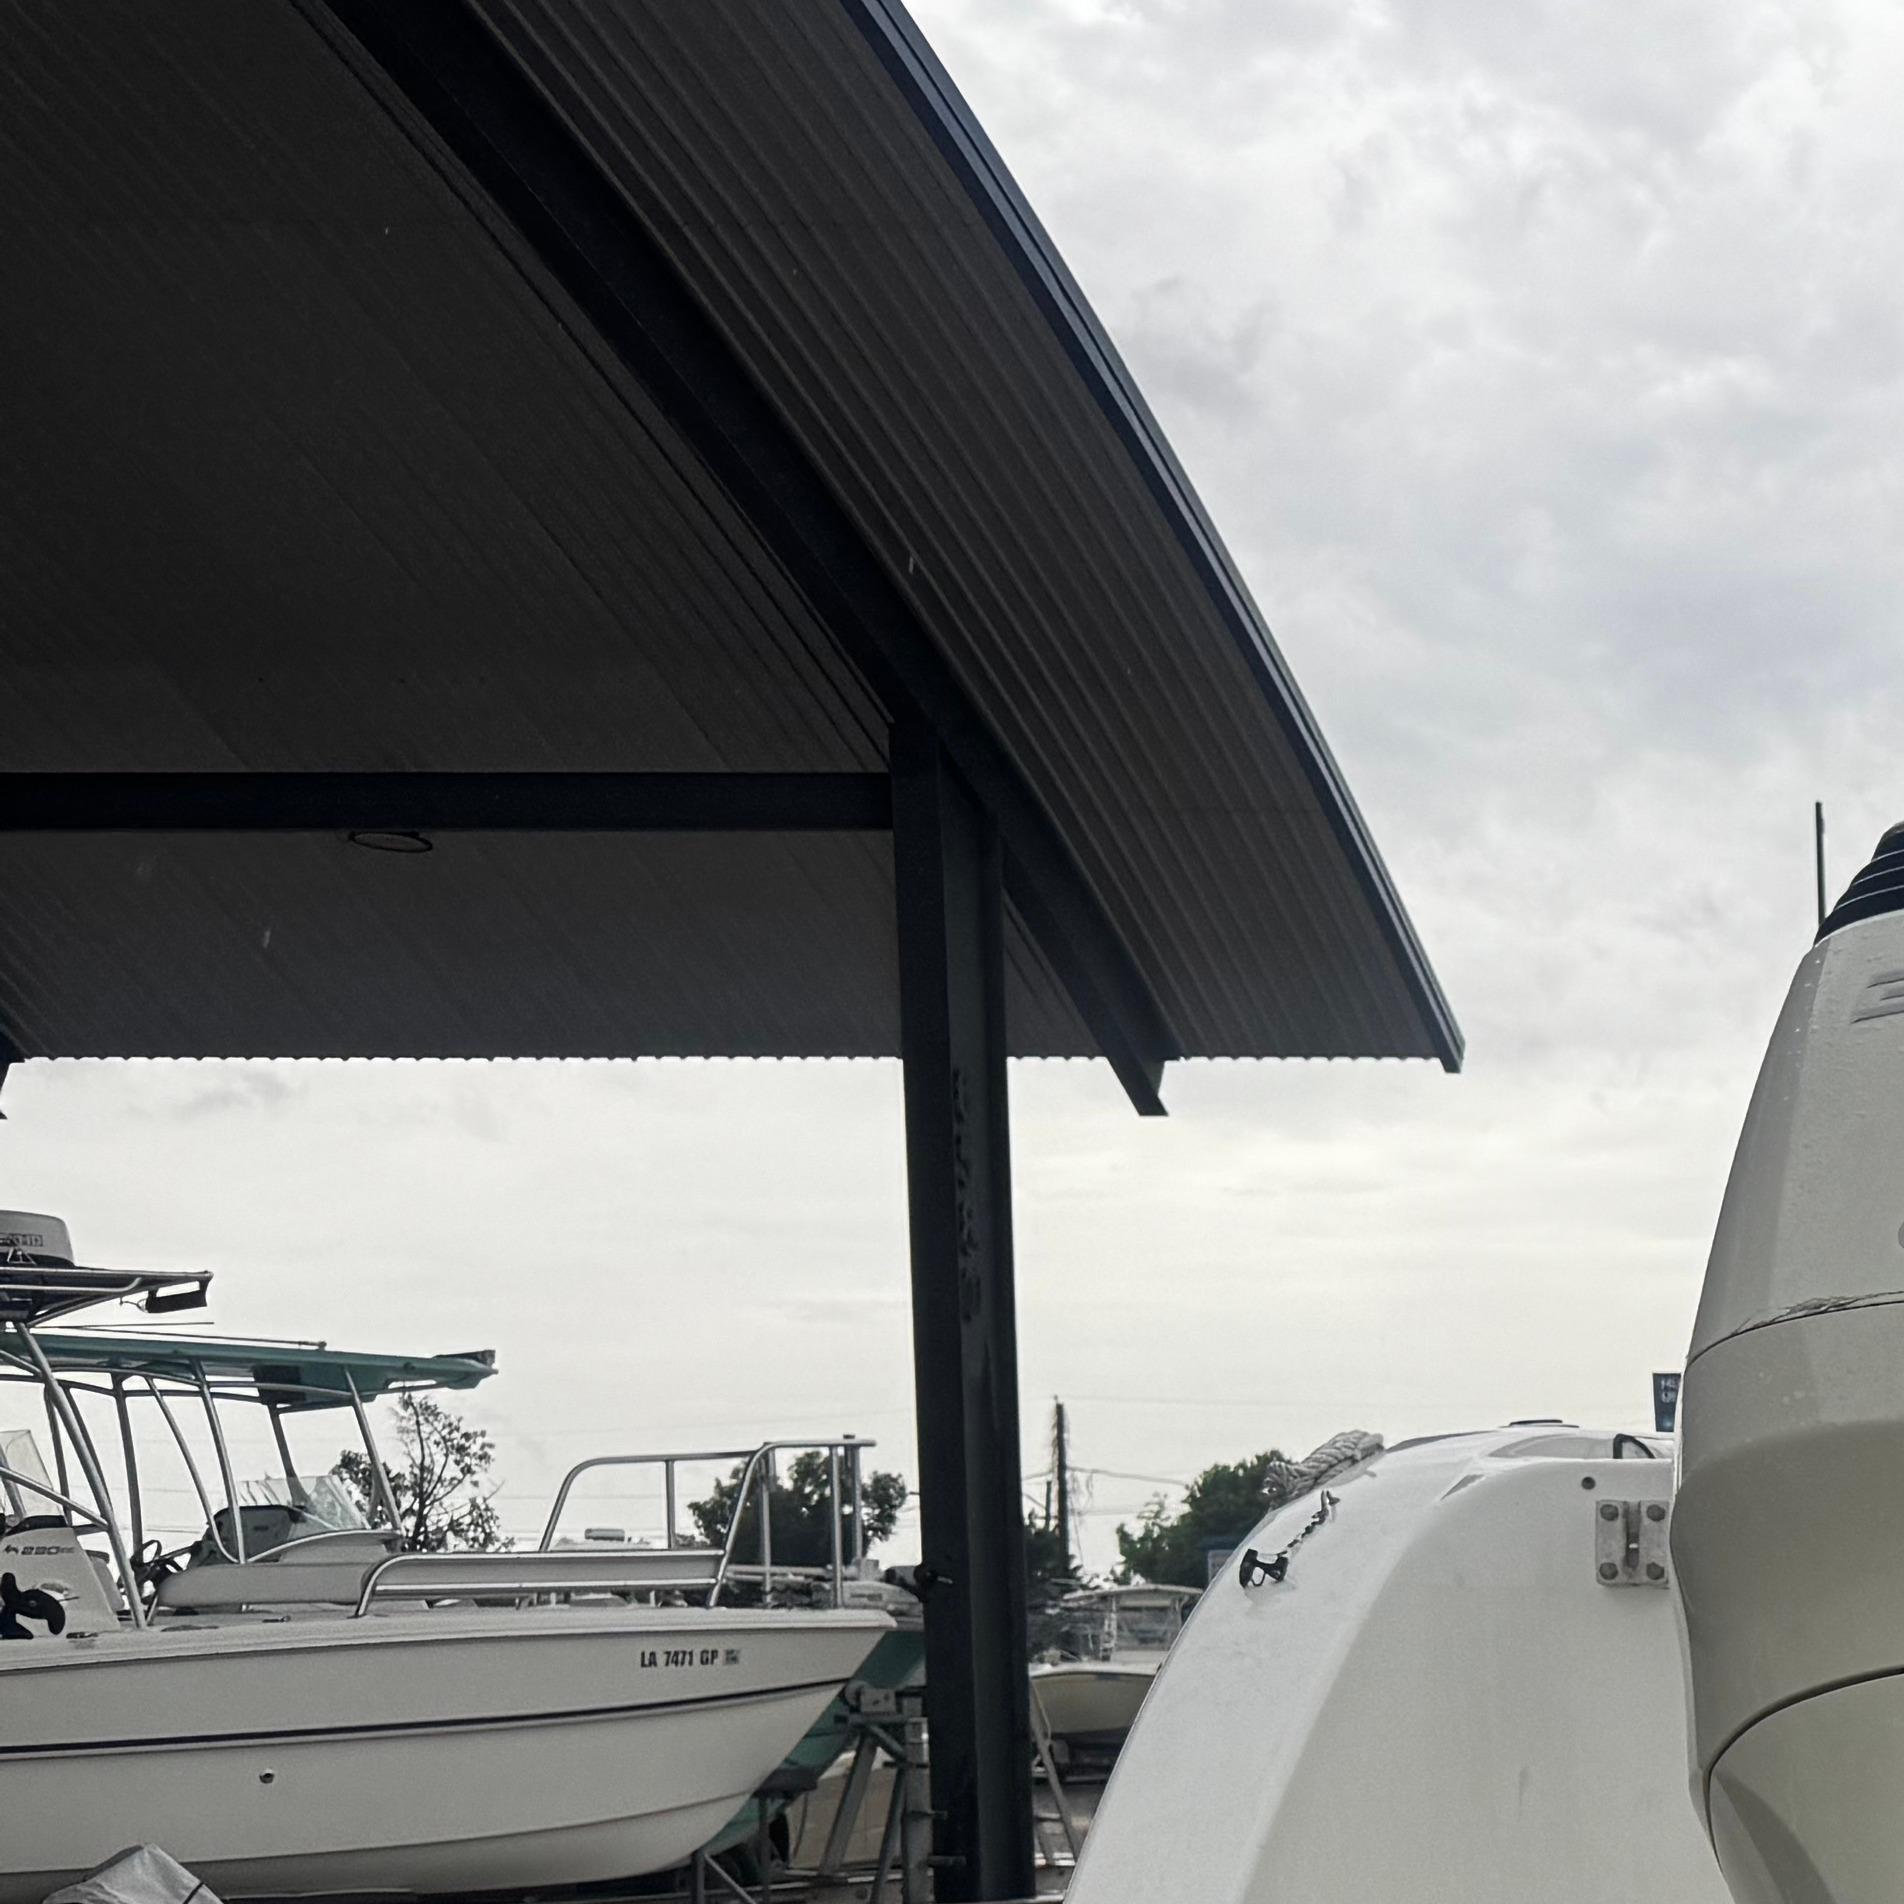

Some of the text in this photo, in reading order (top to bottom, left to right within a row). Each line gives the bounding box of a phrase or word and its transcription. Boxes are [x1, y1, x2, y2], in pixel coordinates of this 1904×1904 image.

[640, 1651, 658, 1668] LA
[663, 1650, 694, 1667] 7471
[699, 1649, 719, 1665] GP
